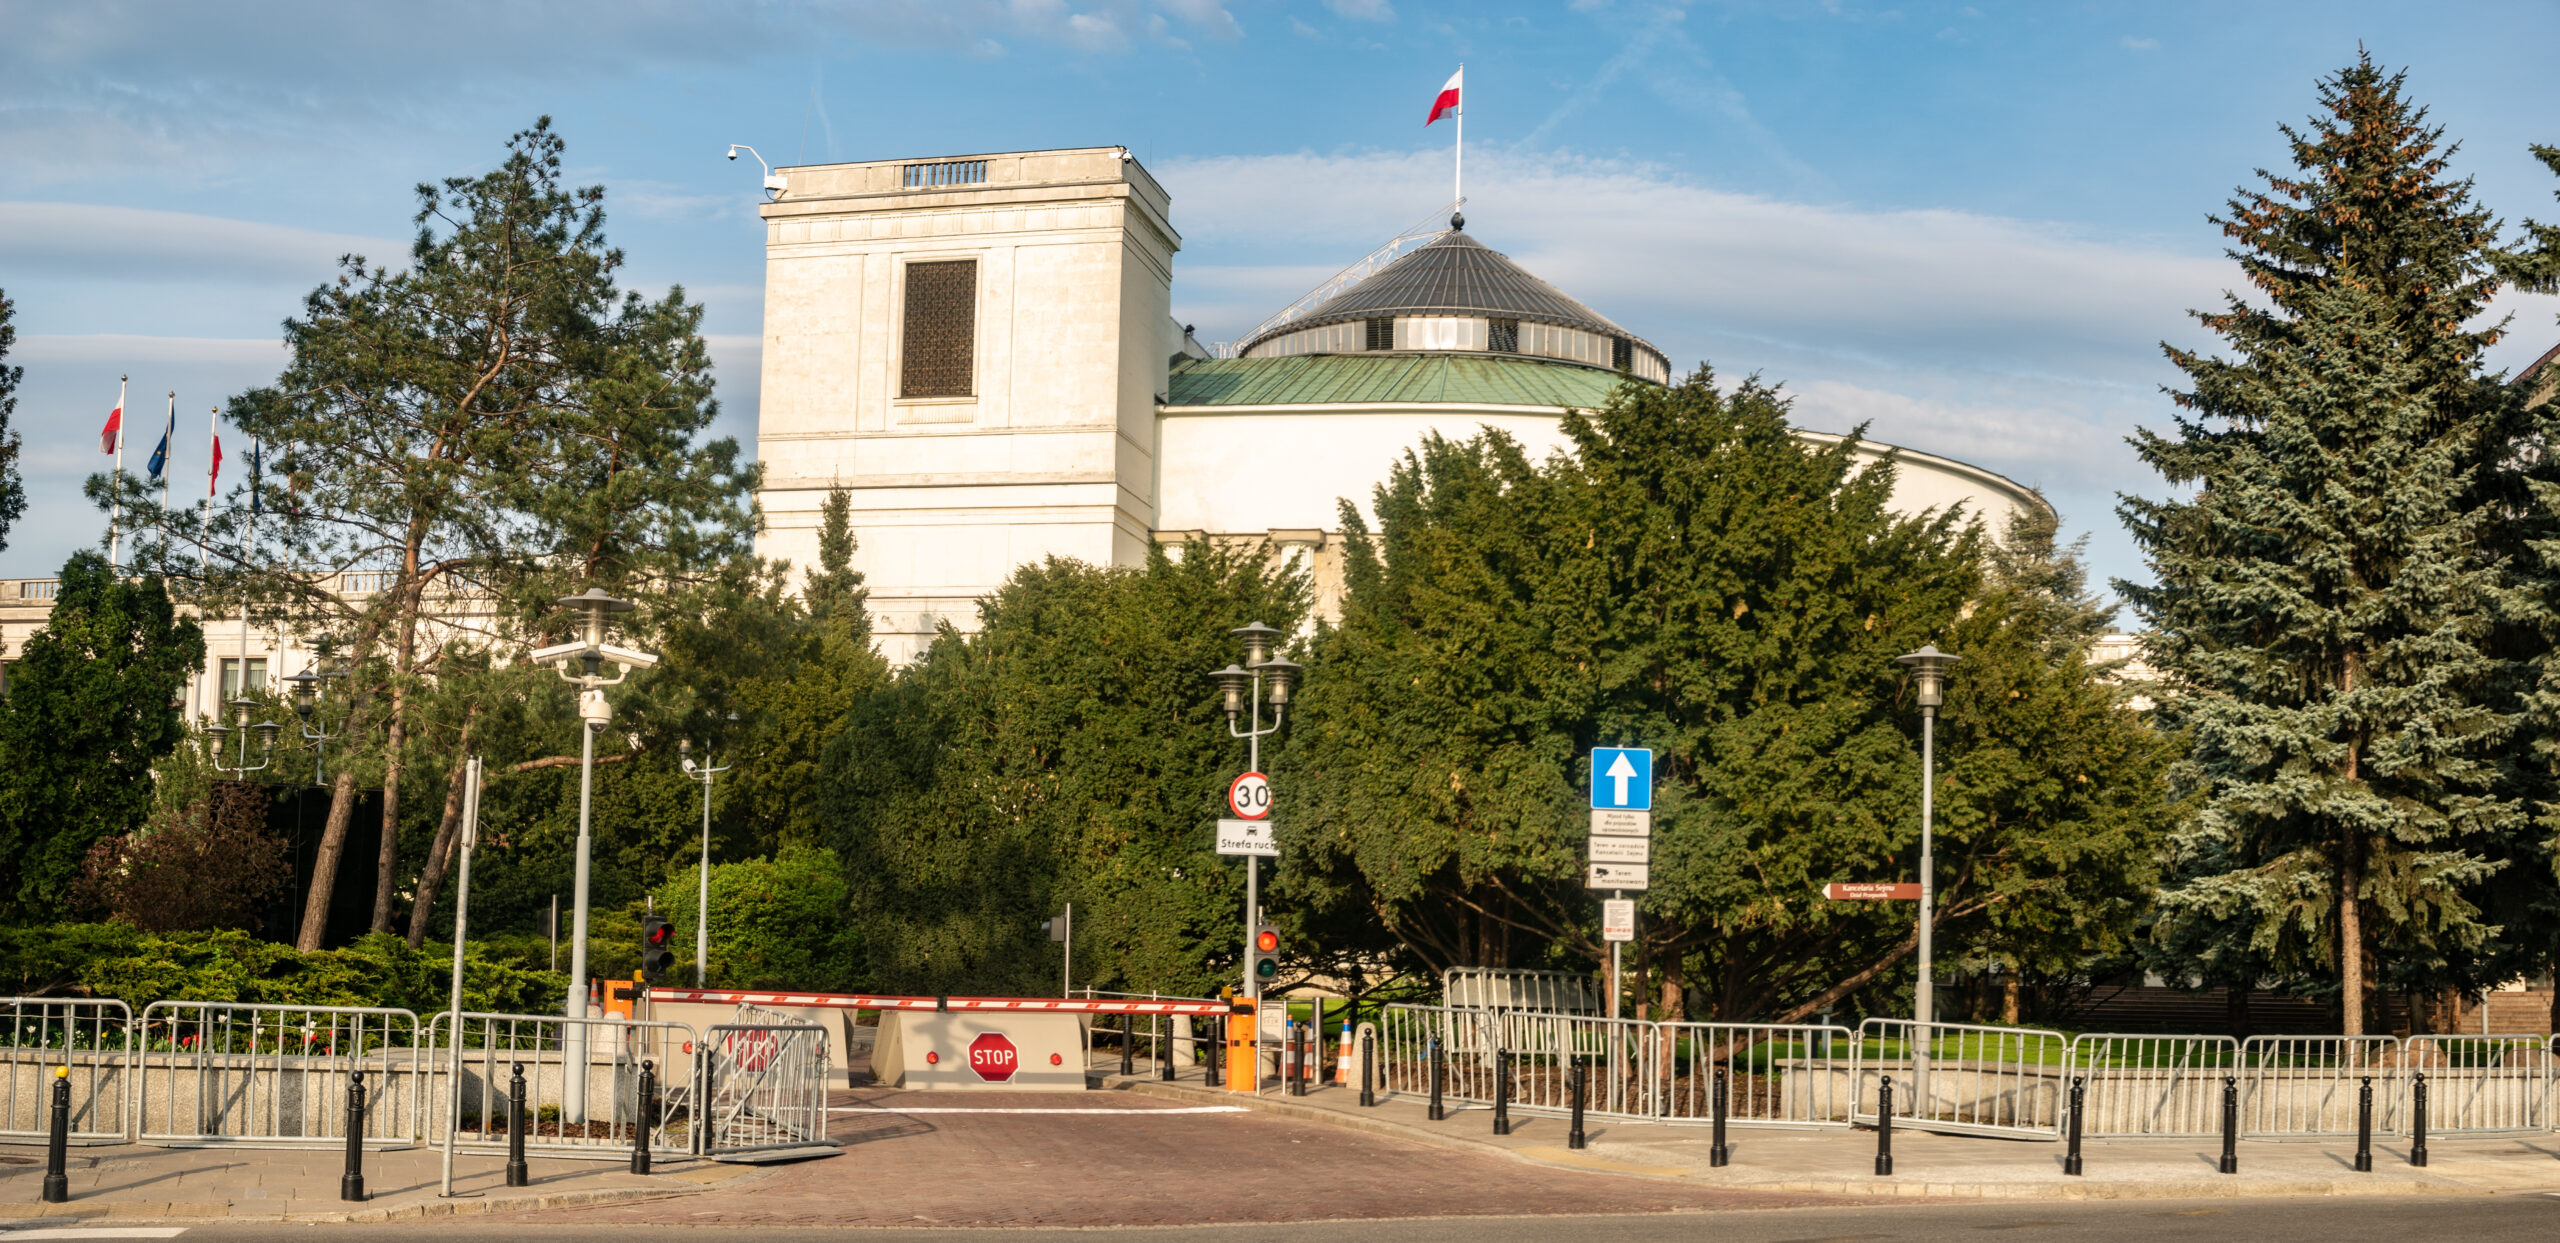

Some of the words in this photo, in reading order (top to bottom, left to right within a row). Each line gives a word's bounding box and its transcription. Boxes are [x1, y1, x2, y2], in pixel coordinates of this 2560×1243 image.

[1237, 785, 1268, 808] 30
[1221, 838, 1252, 849] Strefa
[1842, 884, 1874, 892] Kancelaria
[1875, 884, 1896, 893] Sejmu
[974, 1049, 1014, 1065] STOP
